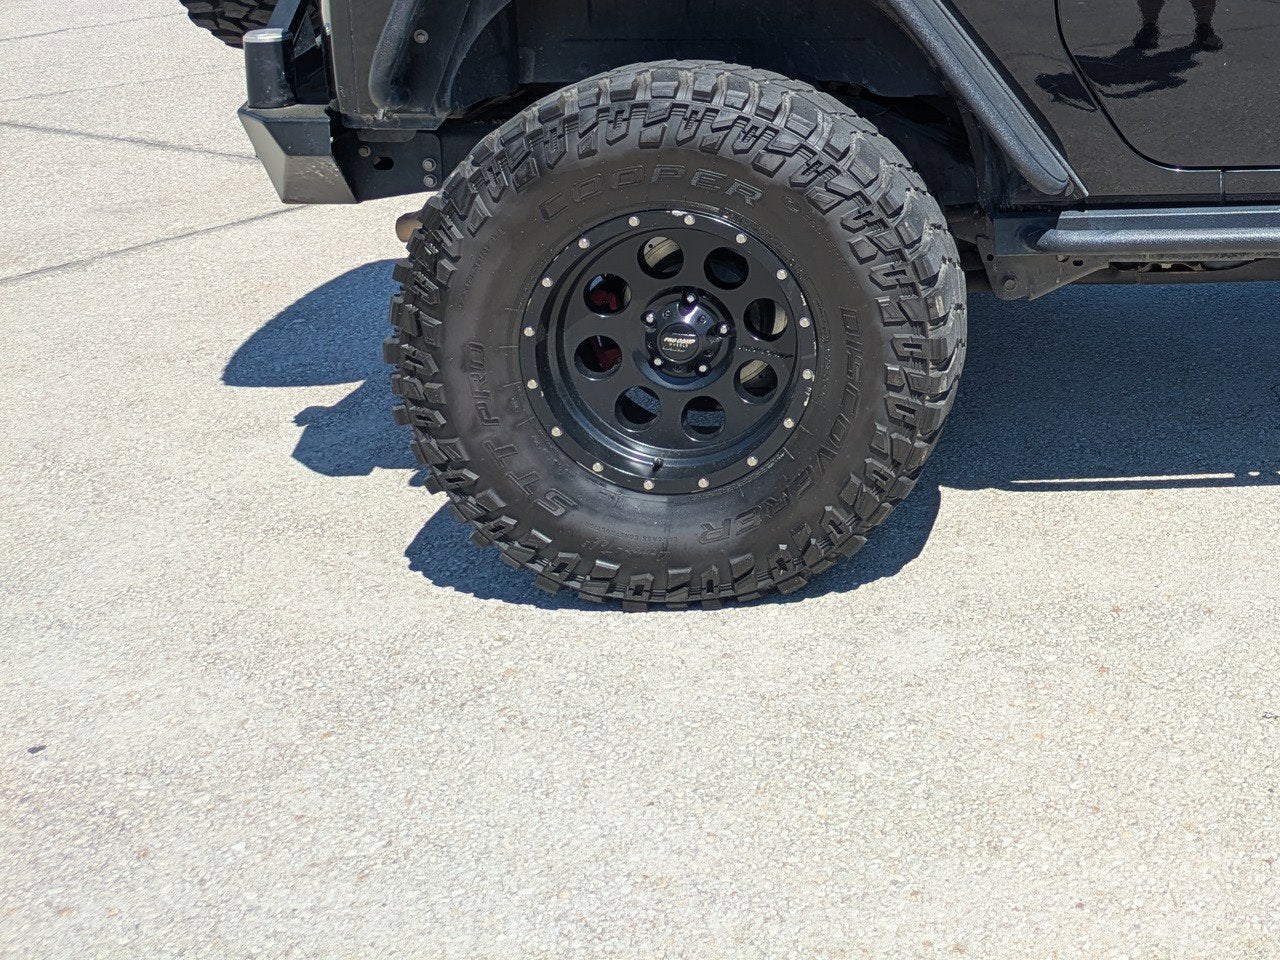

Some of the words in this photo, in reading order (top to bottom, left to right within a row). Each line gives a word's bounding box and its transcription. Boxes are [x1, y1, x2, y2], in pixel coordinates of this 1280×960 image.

[538, 162, 764, 219] COOPER
[468, 340, 501, 435] PRO
[696, 305, 859, 547] DISCOVERER
[486, 436, 574, 519] STT
